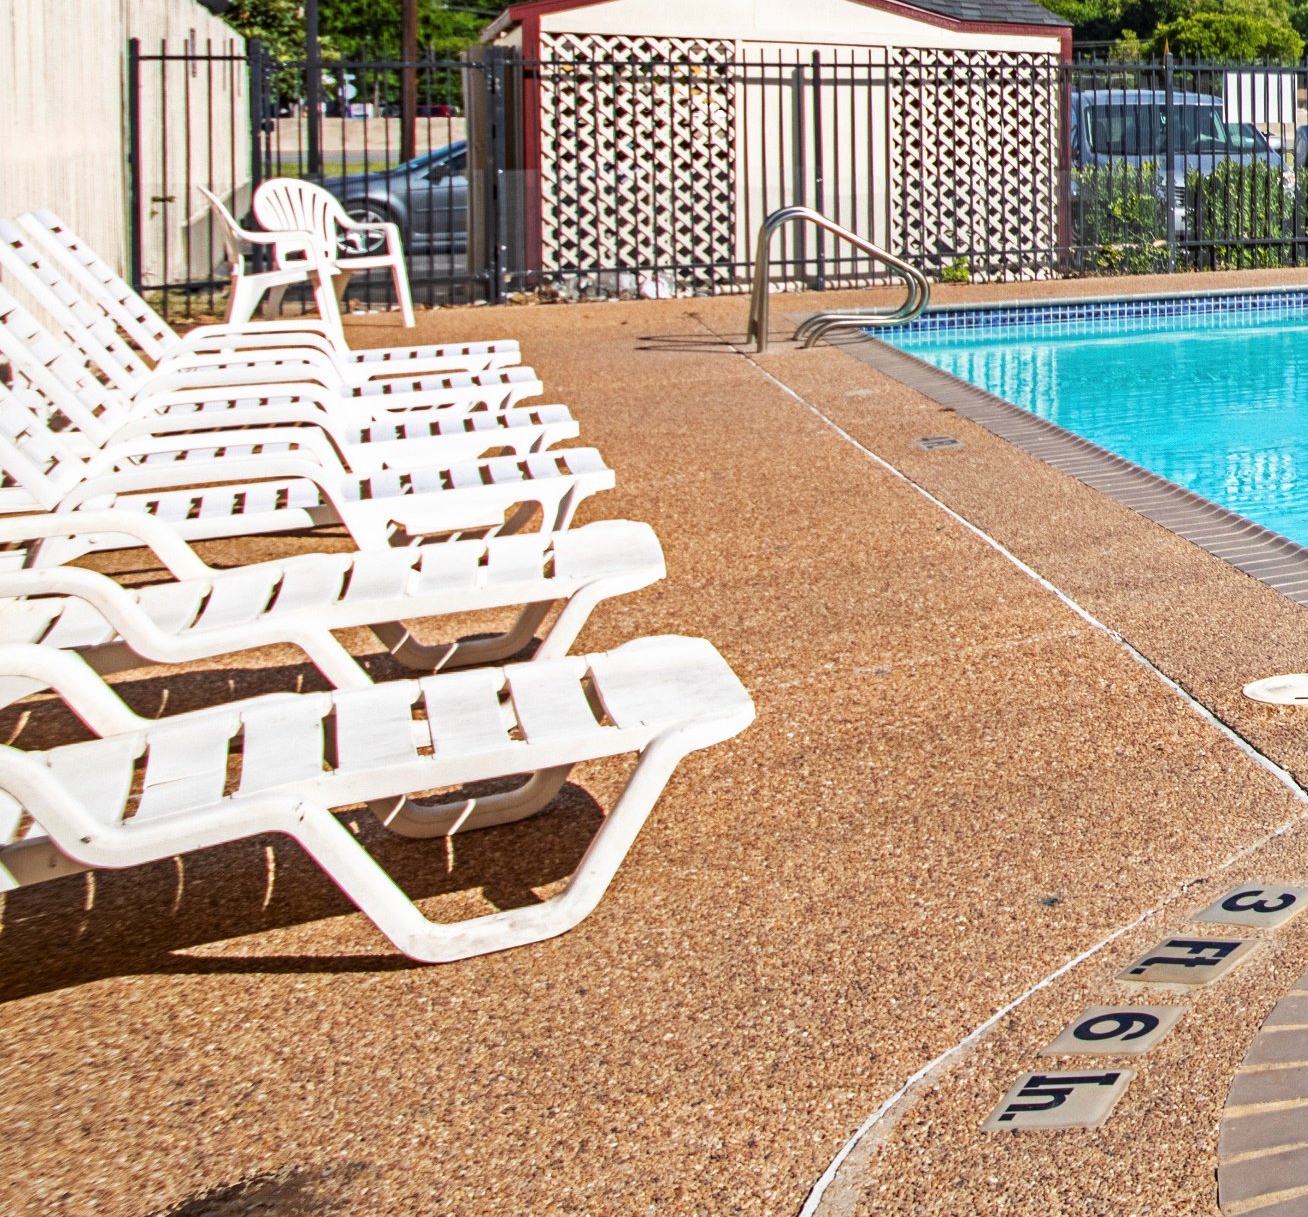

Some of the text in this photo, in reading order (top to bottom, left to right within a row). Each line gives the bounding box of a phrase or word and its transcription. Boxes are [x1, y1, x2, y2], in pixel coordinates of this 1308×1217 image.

[997, 889, 1297, 1122] 3 Ft. 6 In.
